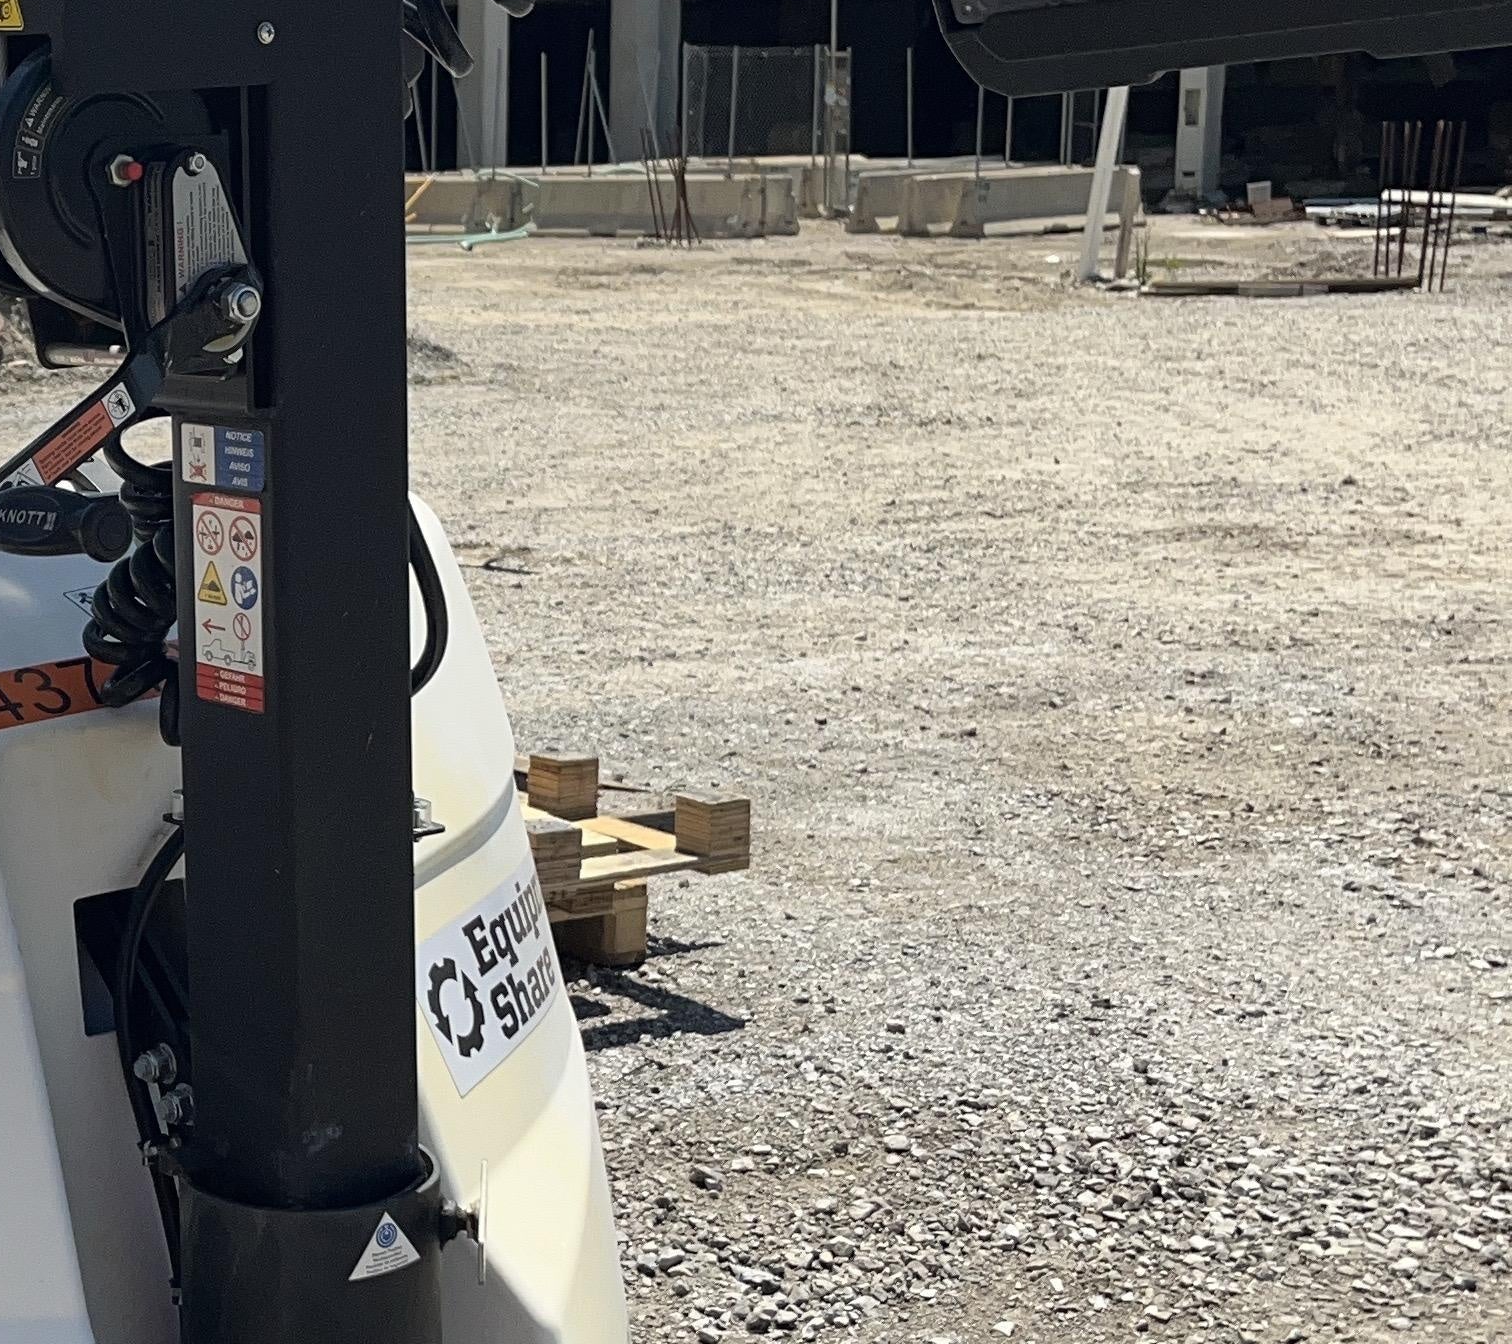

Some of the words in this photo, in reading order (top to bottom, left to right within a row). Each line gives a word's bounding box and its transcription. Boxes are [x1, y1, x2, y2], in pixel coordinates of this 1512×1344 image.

[225, 431, 252, 443] NOTICE
[215, 496, 244, 508] DANGER
[489, 945, 557, 1040] Share
